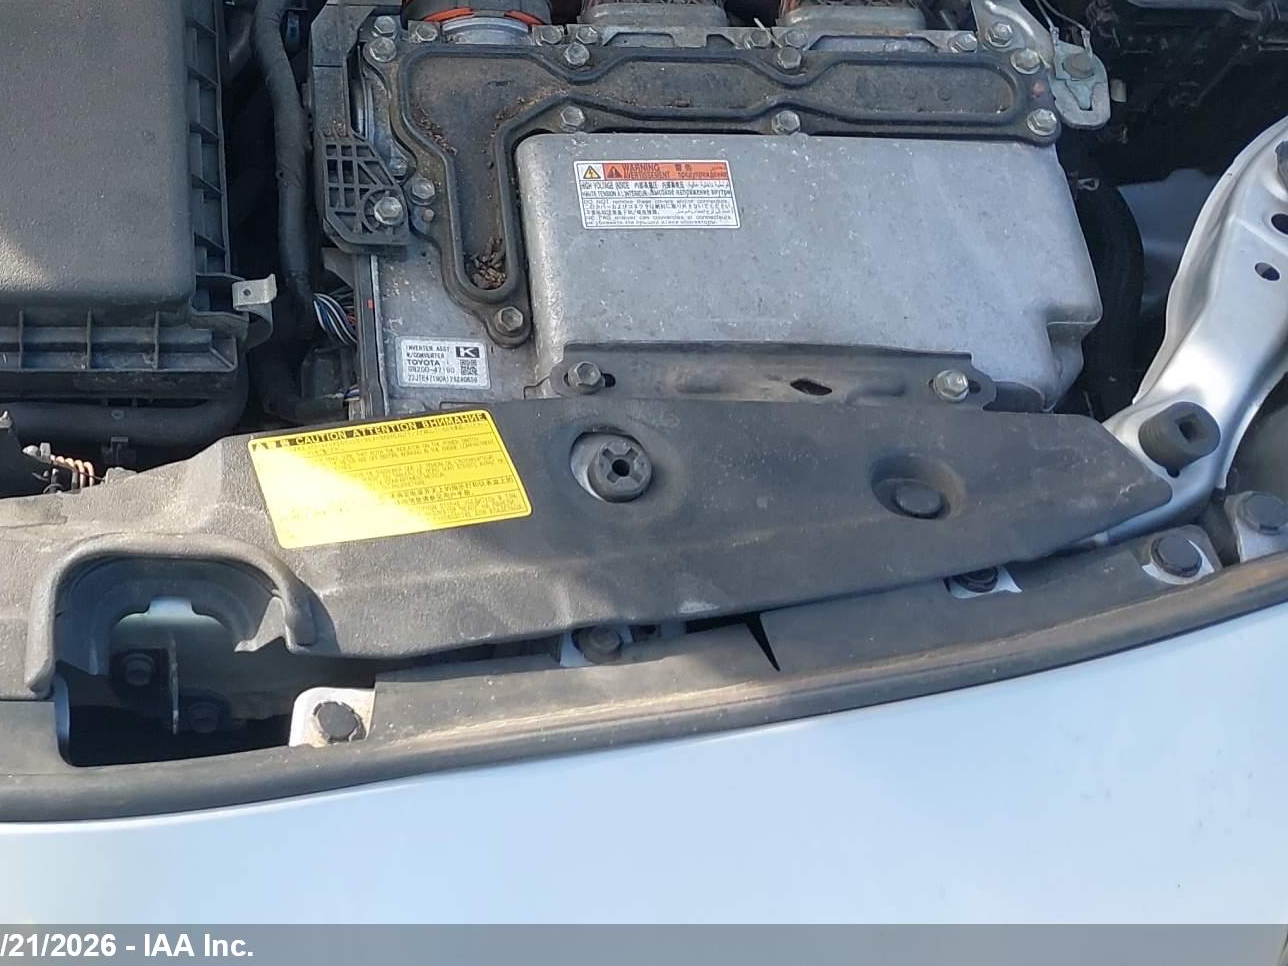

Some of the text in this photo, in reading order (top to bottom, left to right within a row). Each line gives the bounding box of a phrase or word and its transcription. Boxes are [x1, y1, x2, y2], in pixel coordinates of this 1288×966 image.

[623, 163, 660, 172] WARNING
[295, 431, 346, 445] CAUTION
[353, 422, 419, 439] ATTENTION
[423, 413, 486, 431] ВНИМАНИЕ
